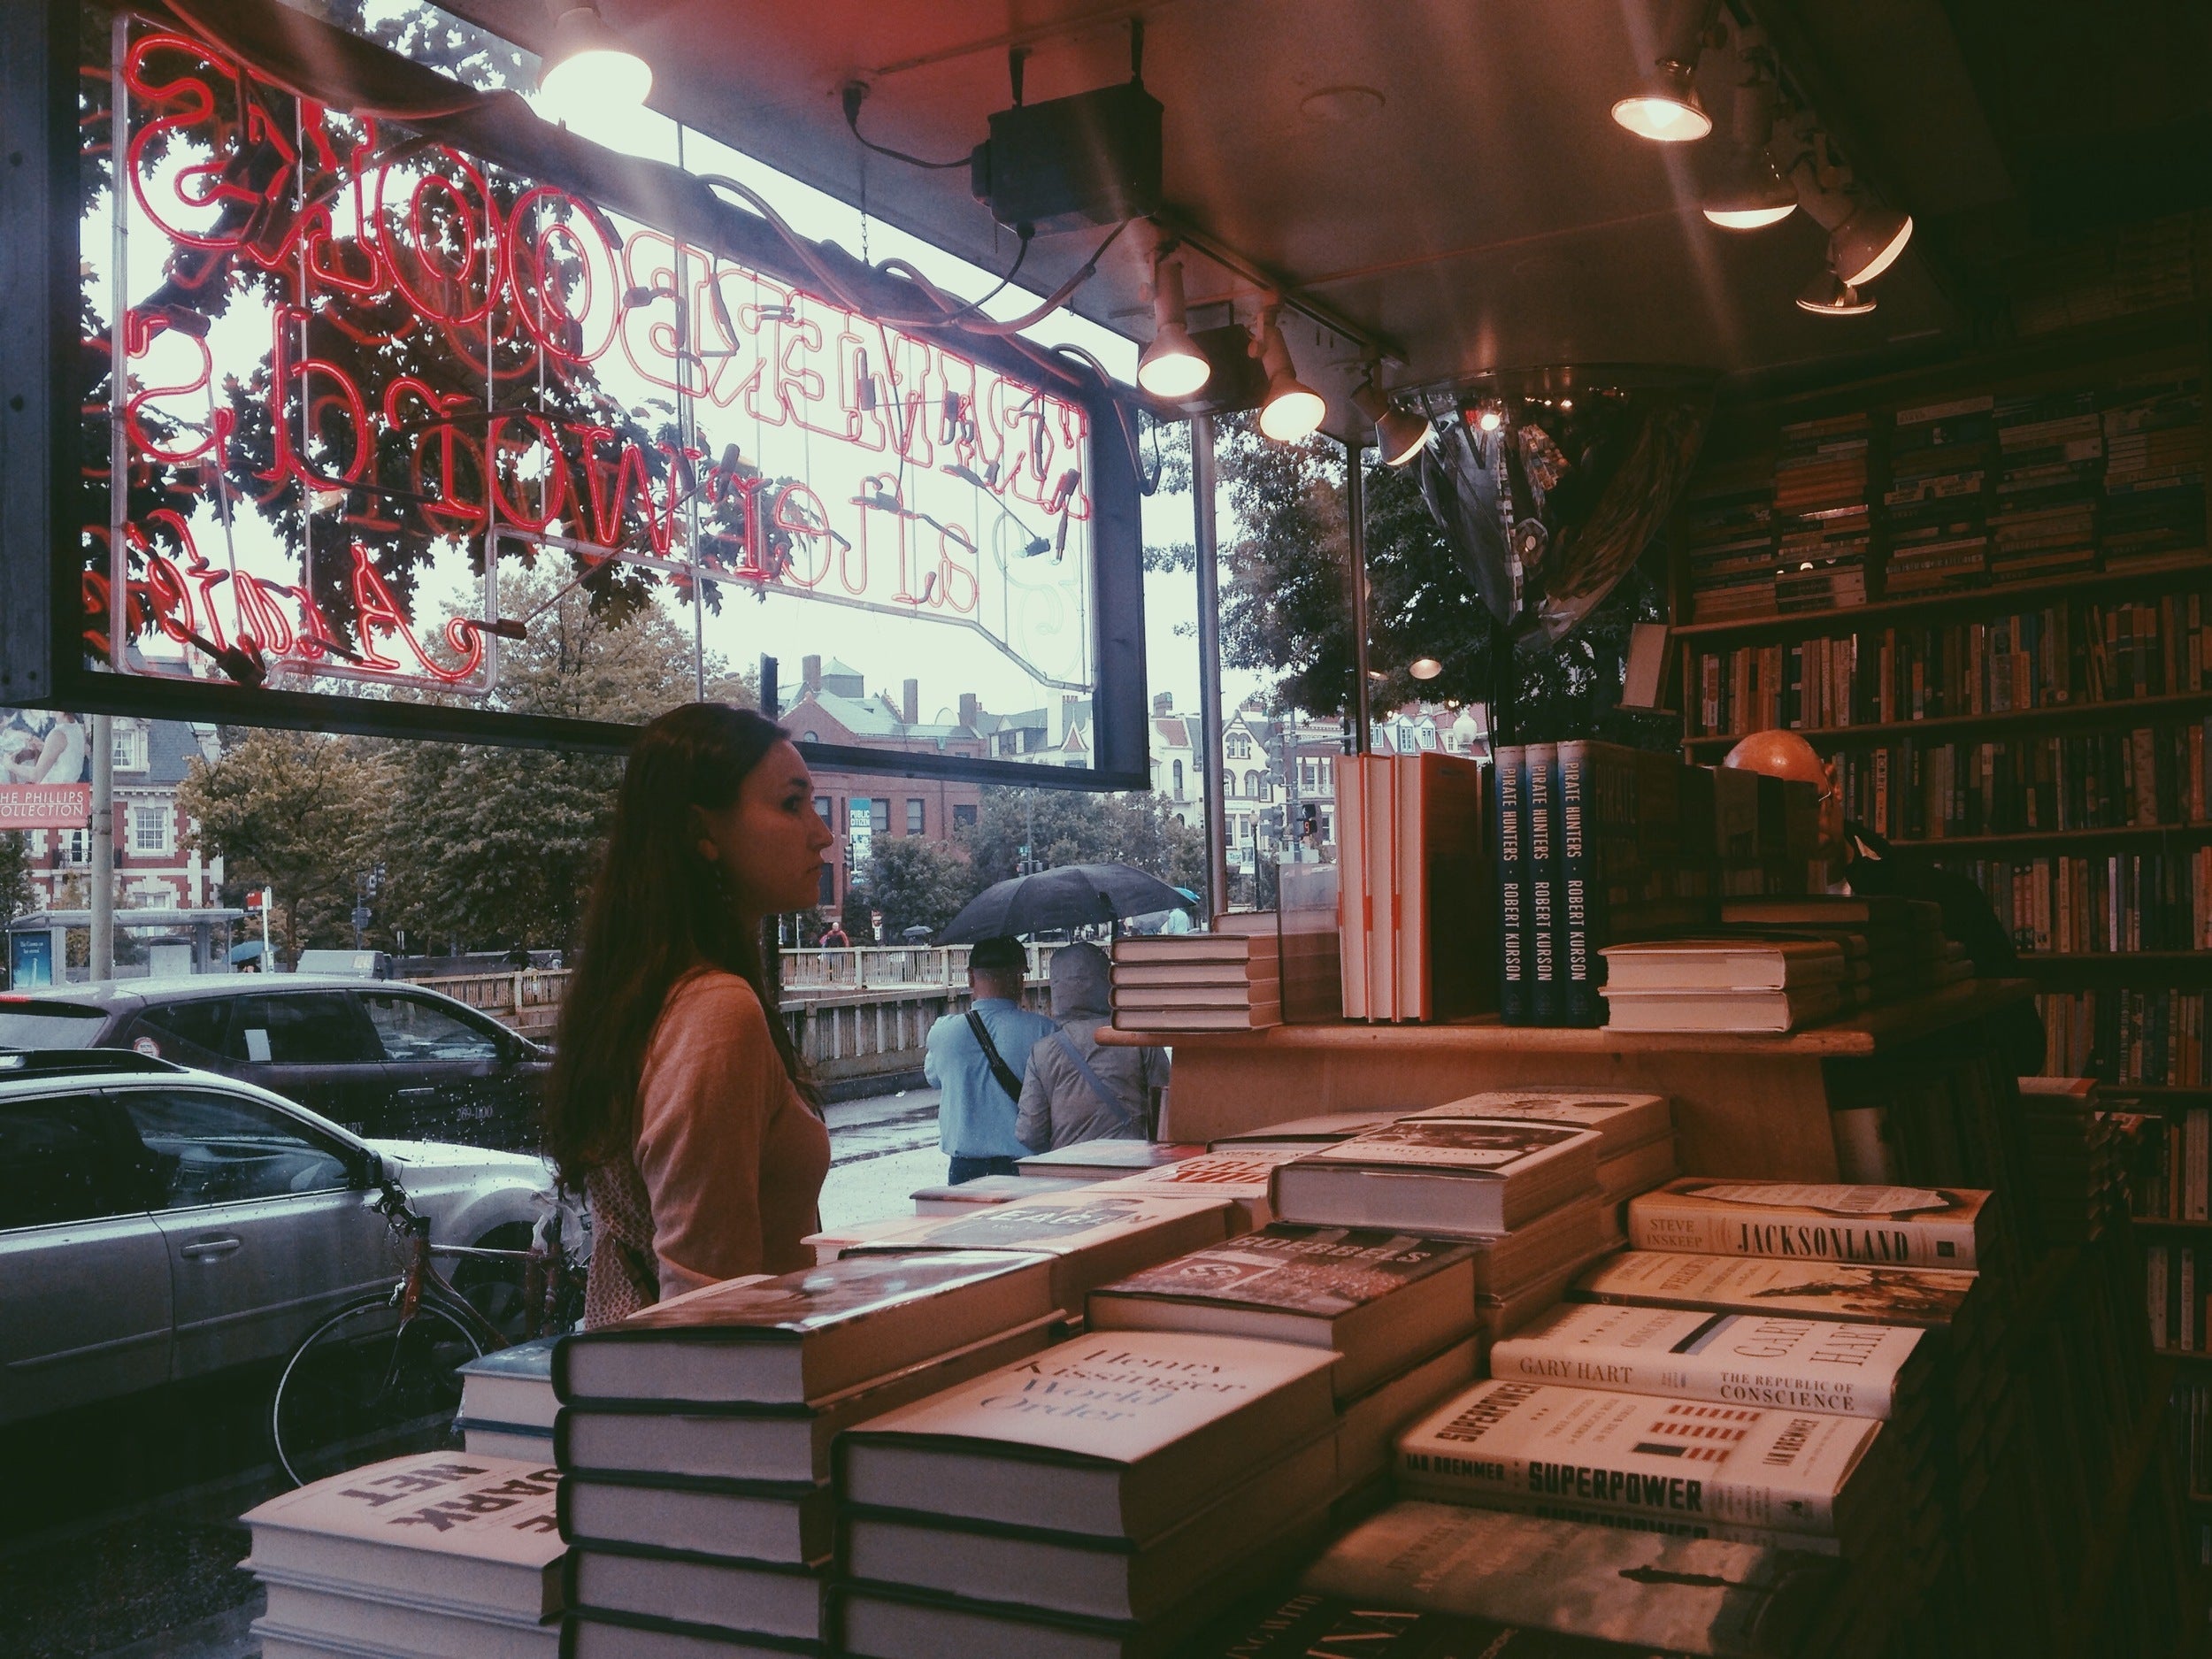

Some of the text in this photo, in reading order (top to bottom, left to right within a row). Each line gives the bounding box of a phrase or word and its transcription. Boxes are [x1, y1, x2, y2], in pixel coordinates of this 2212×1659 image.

[0, 790, 84, 803] HE PHILLIPS
[0, 804, 83, 817] OLLECTION
[849, 810, 871, 818] PUBLIC
[849, 818, 871, 826] CITIZEN
[1502, 768, 1520, 981] PIRATE HUNTERS ROBERT KURSON
[1532, 765, 1552, 981] PIRATE HUNTERS ROBERT KURSON
[1564, 762, 1586, 980] PIRATE HUNTERS ROBERT KURSON
[1649, 1218, 1695, 1233] STEVE
[1228, 1237, 1432, 1263] GOEBBELS
[1646, 1233, 1702, 1248] INSKEEP
[1737, 1222, 1909, 1262] JACKSONLAND
[1082, 1349, 1236, 1377] Henry
[1519, 1356, 1633, 1385] GARY HART
[1014, 1361, 1247, 1394] Kissinger
[1720, 1371, 1855, 1394] THE REPUBLIC OF
[1023, 1379, 1176, 1406] World
[1719, 1386, 1856, 1412] CONSCIENCE
[980, 1396, 1137, 1421] Order
[1434, 1383, 1542, 1442] SUPERPOWER
[1432, 1456, 1506, 1480] BREMMER
[337, 1463, 490, 1508] NET
[1528, 1462, 1703, 1513] SUPERPOWER
